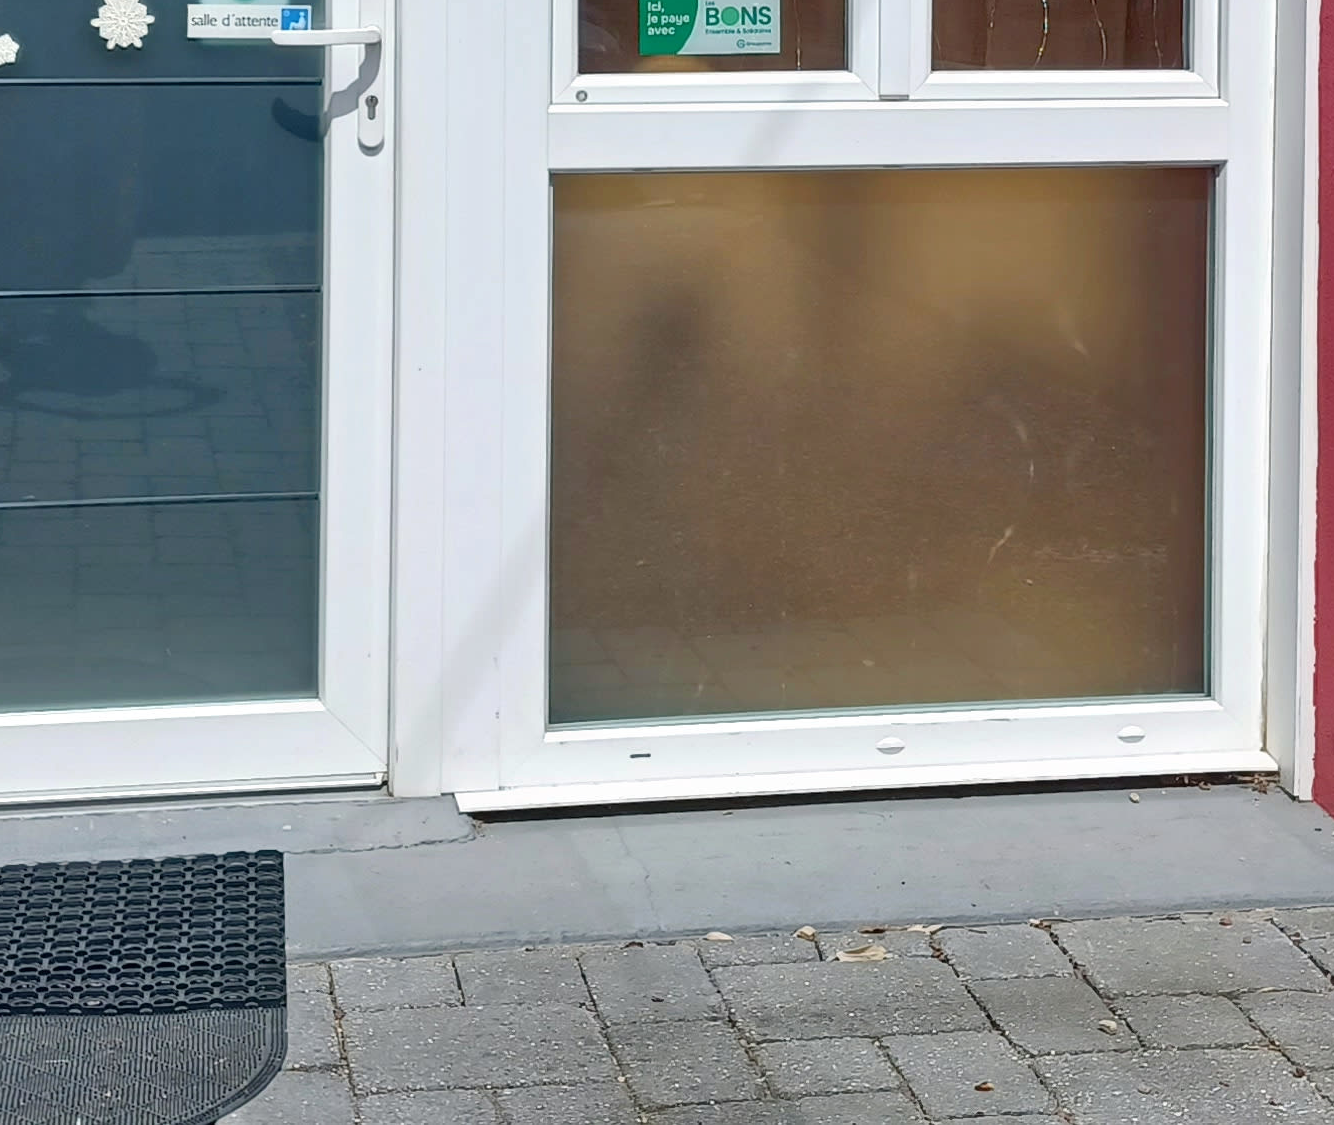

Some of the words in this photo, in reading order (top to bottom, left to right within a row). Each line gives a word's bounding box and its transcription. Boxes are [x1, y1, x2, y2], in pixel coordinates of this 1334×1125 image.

[647, 1, 665, 13] Ici,
[191, 15, 217, 27] salle
[647, 13, 658, 26] je
[661, 15, 690, 26] paye
[705, 6, 772, 26] BONS
[647, 25, 676, 36] avec
